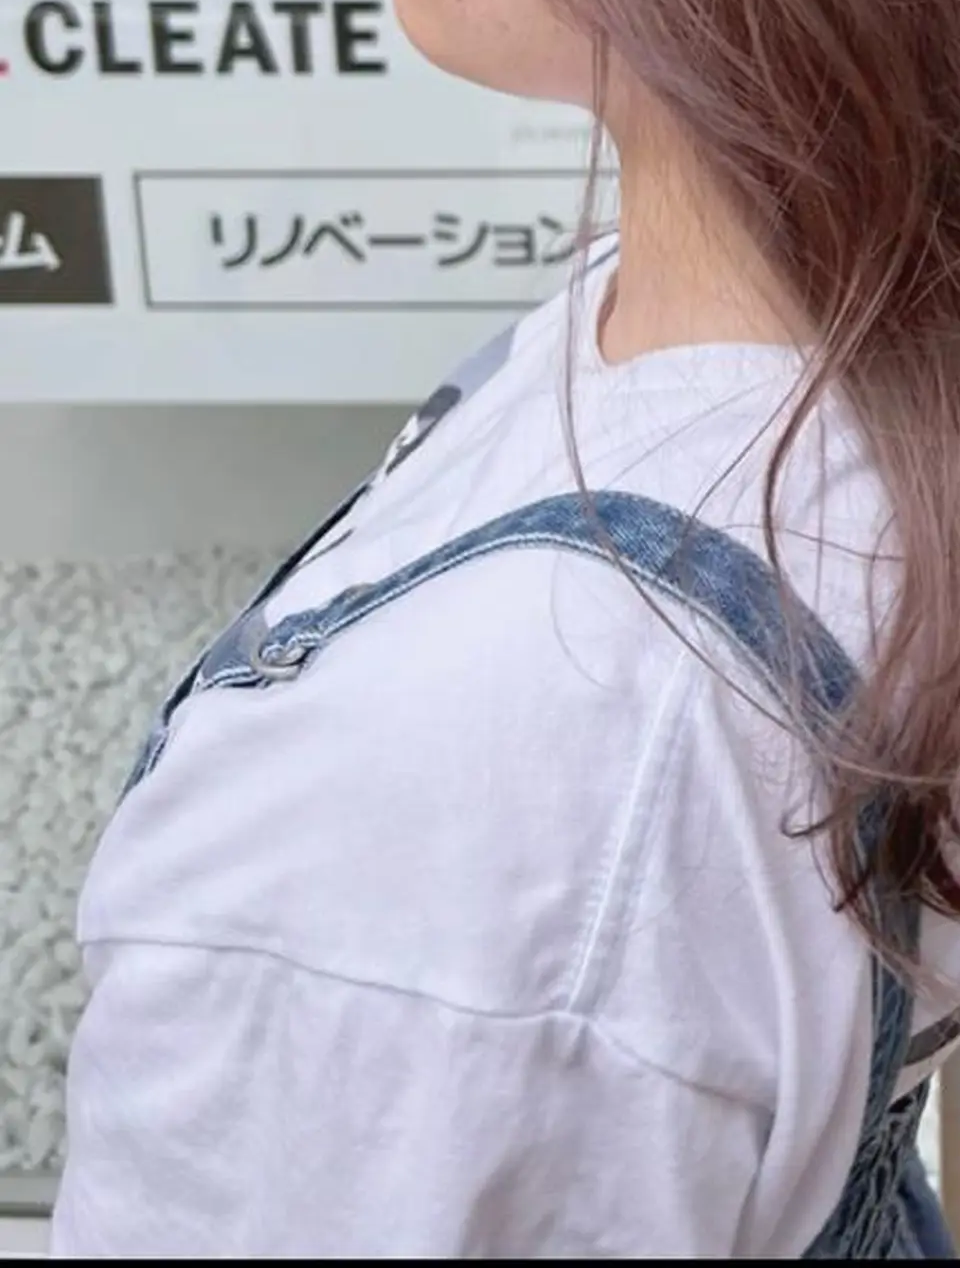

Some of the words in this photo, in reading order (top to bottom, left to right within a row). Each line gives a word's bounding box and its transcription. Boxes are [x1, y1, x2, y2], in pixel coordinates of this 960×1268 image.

[0, 211, 61, 271] ム
[209, 211, 580, 270] リノベーション
